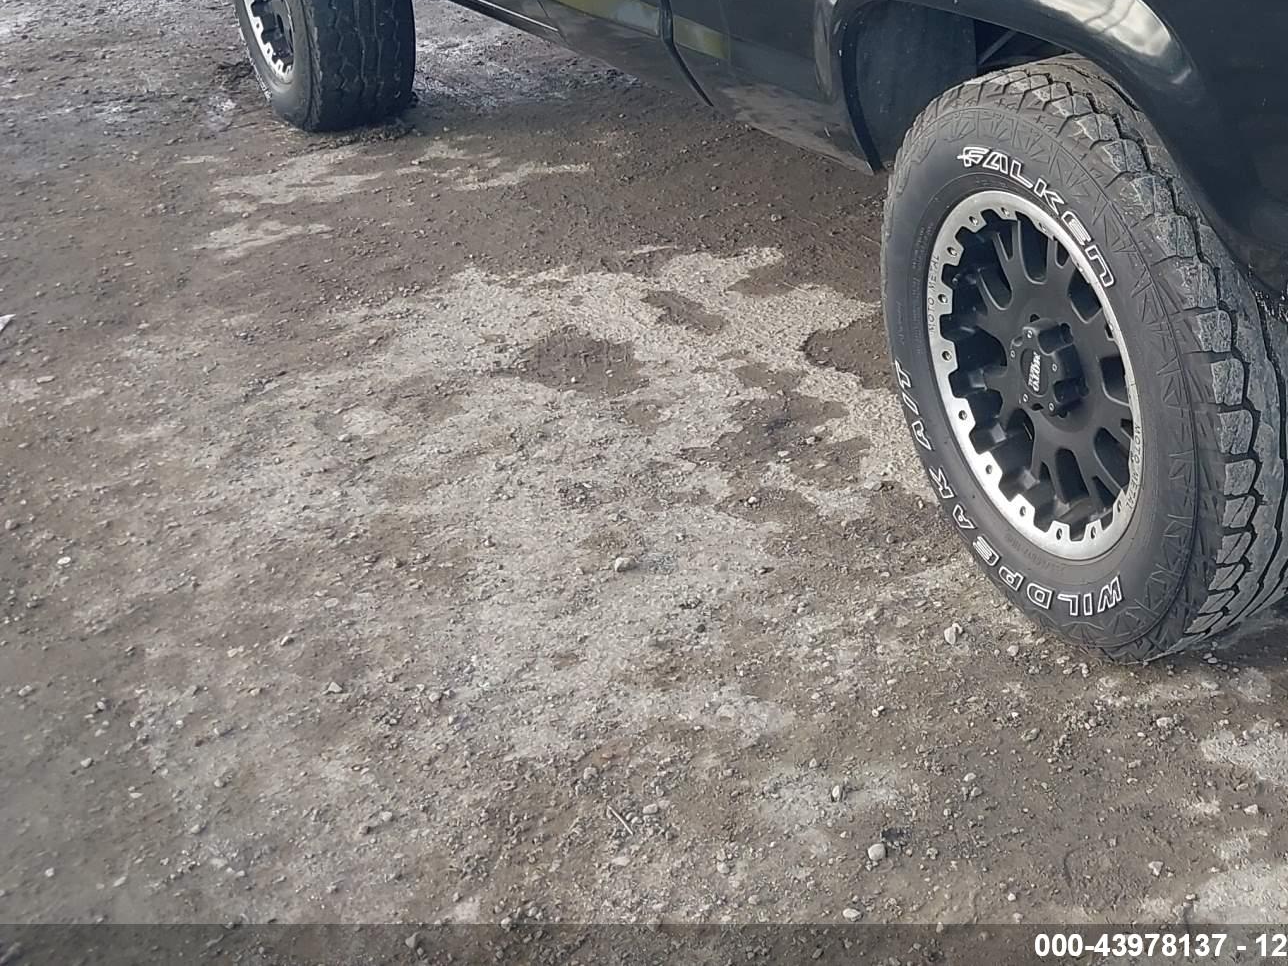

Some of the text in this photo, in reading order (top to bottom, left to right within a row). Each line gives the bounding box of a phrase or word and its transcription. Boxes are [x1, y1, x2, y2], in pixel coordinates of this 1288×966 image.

[956, 146, 1115, 288] FALKEN
[894, 359, 933, 451] A/T
[928, 465, 1123, 617] WILDPEAK
